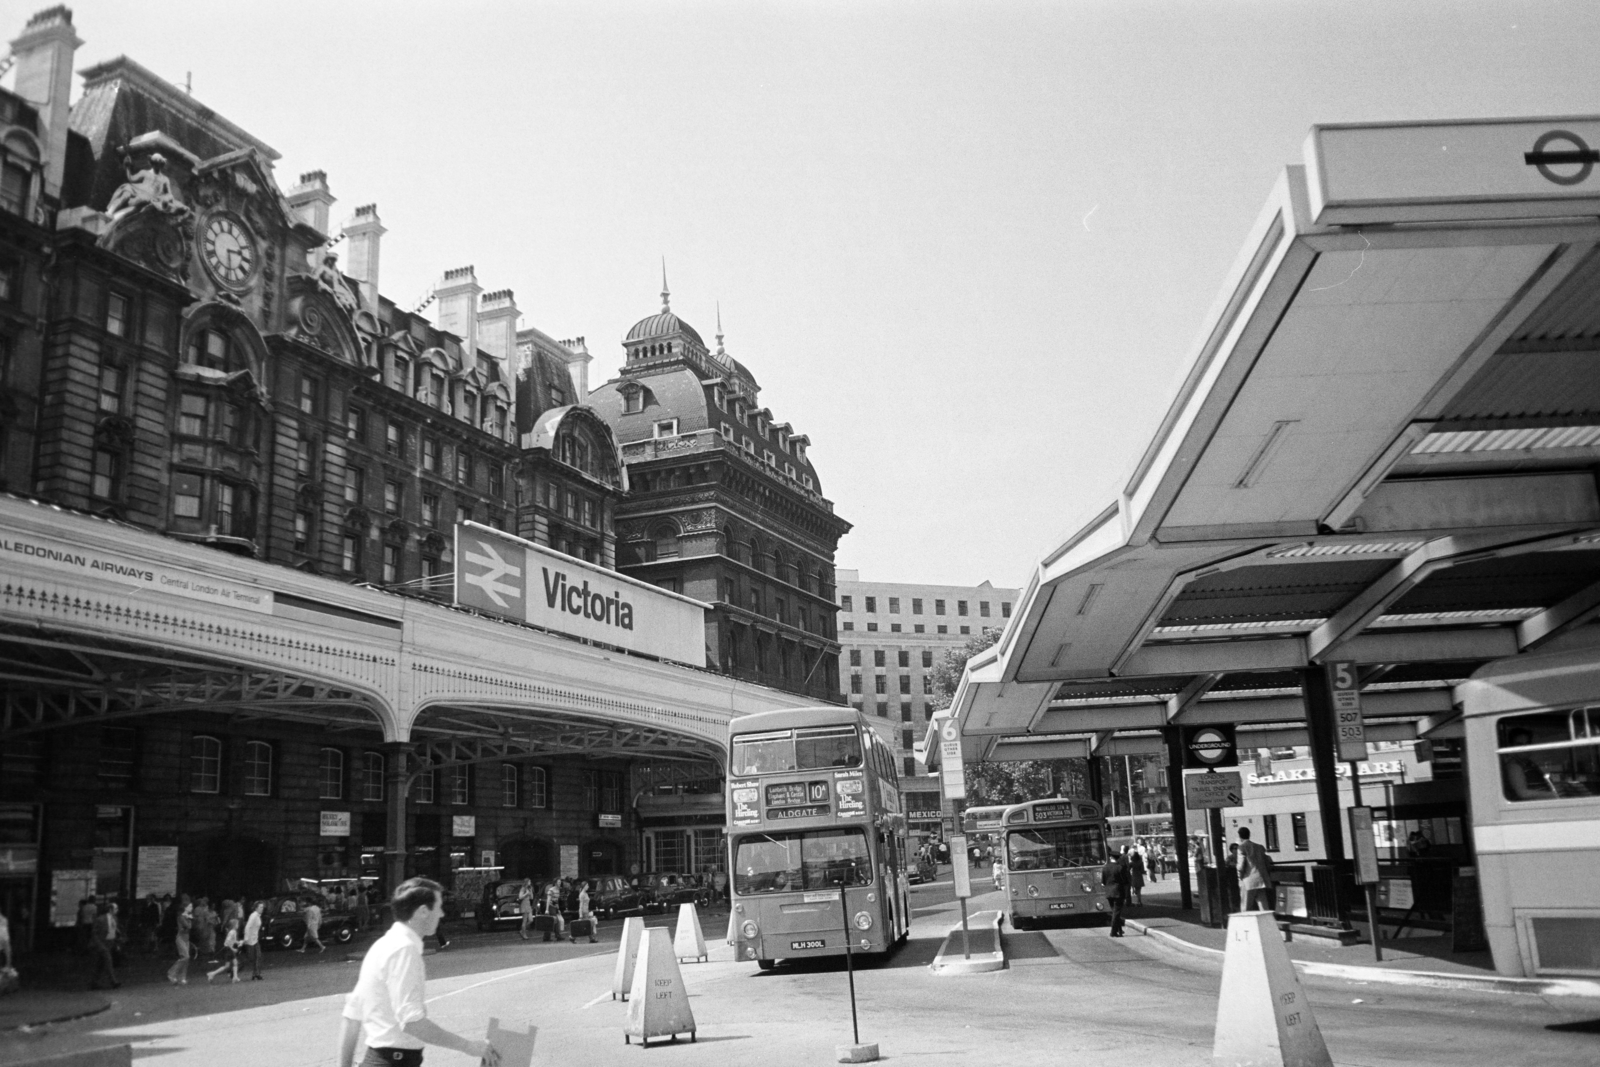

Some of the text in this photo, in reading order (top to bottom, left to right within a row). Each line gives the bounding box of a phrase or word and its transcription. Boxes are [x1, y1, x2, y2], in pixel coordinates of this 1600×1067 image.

[90, 559, 153, 581] AIRWAYS
[160, 575, 260, 605] Central London Air Terminal
[542, 566, 633, 631] Victoria
[1335, 662, 1352, 689] 5
[1340, 712, 1358, 722] 507
[942, 719, 957, 741] 6
[1341, 727, 1362, 737] 503
[812, 784, 826, 799] 10A
[840, 794, 852, 802] The
[777, 808, 817, 819] ALDGATE
[909, 810, 942, 818] MEXICO
[1035, 811, 1047, 820] 503
[654, 979, 673, 987] KEEP
[655, 991, 672, 999] LEFT
[1284, 1012, 1302, 1026] LEFT
